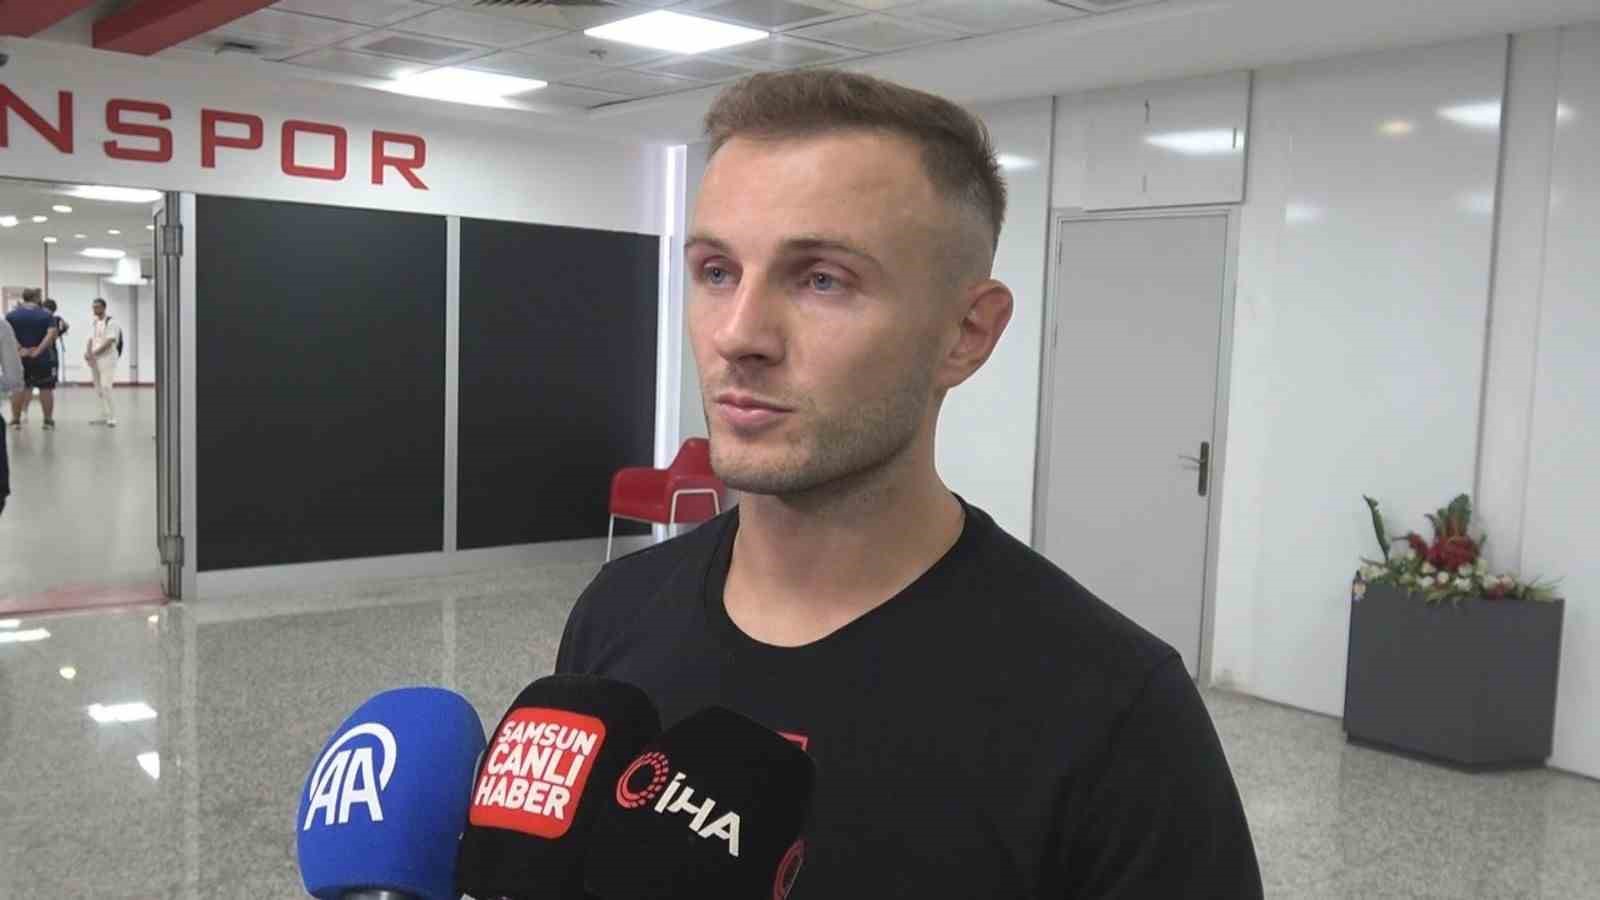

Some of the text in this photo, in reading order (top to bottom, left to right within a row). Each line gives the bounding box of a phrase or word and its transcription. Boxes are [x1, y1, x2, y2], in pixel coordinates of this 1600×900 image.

[0, 84, 429, 190] NSPOR
[488, 744, 585, 786] CANLI
[499, 720, 598, 756] SAMSUN
[303, 748, 383, 831] AA
[474, 776, 571, 820] HABER
[654, 772, 741, 857] İHA
